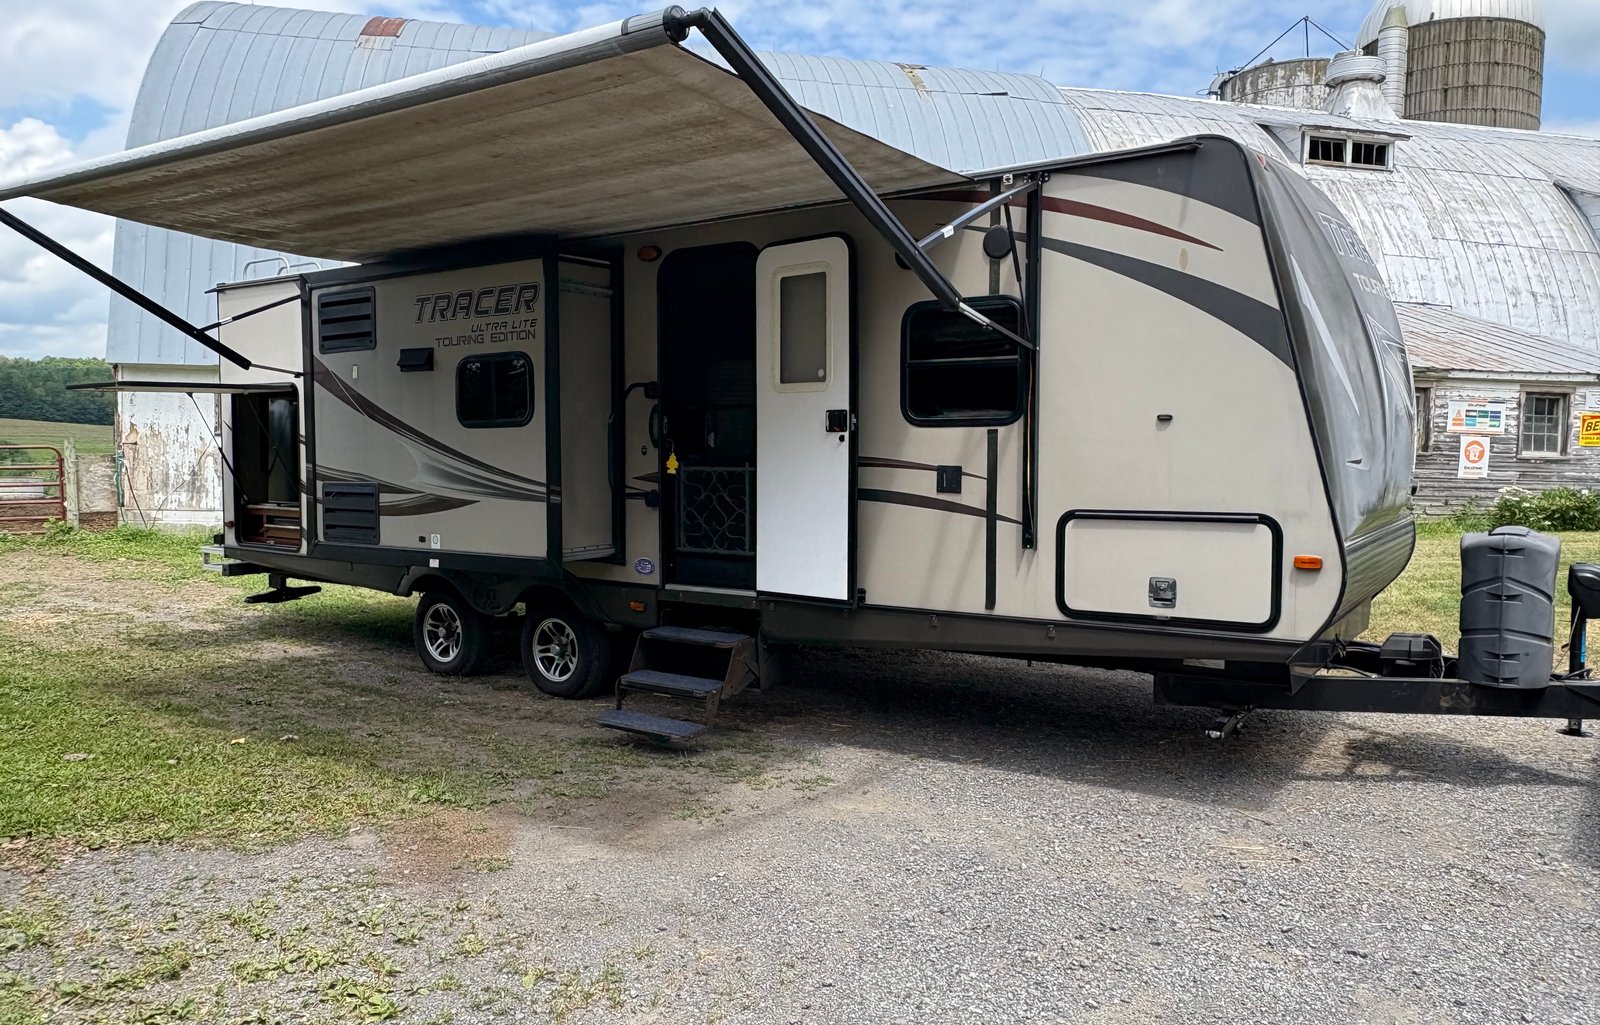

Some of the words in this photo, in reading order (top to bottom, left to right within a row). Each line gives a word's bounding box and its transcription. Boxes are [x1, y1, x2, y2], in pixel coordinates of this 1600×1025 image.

[414, 282, 540, 324] TRACER
[471, 322, 508, 333] ULTRA
[512, 319, 538, 330] LITE
[435, 333, 485, 348] TOURING
[490, 329, 536, 343] EDITION
[1585, 421, 1600, 432] BE
